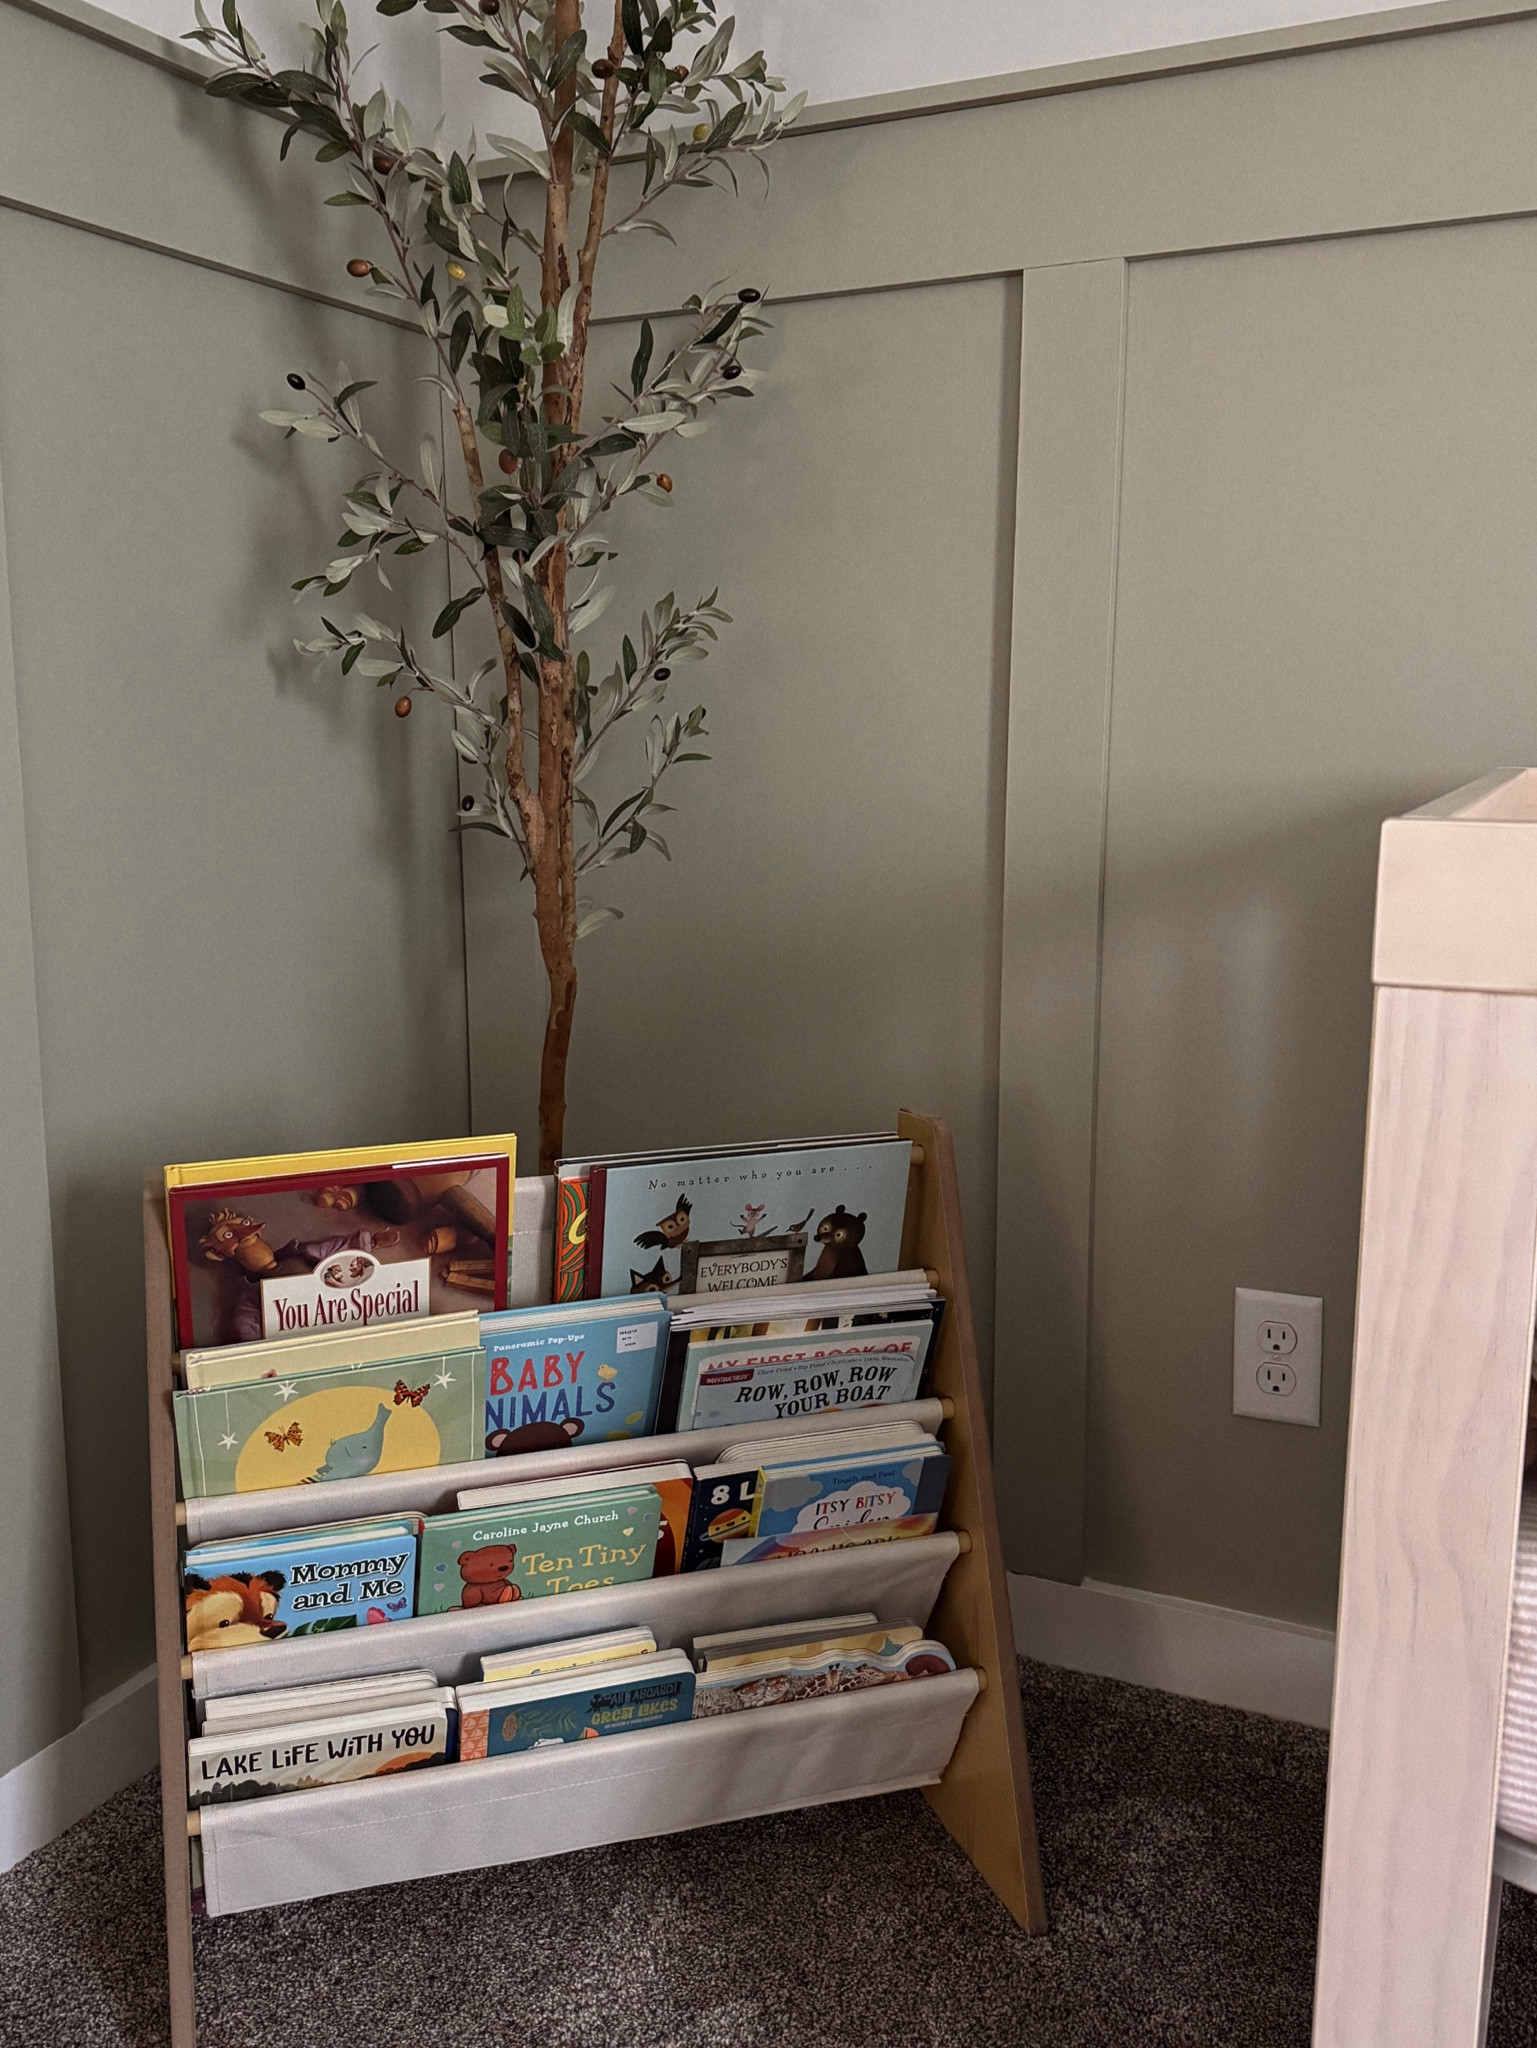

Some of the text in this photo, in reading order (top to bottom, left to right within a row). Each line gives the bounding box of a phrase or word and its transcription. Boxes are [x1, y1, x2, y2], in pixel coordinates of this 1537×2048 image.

[648, 1179, 666, 1190] No
[677, 1175, 730, 1187] matter
[739, 1170, 767, 1181] who
[776, 1168, 802, 1180] you
[700, 1258, 788, 1278] EVERYBODY'S
[708, 1275, 778, 1292] WELCOME
[272, 1280, 419, 1332] You Are Special
[493, 1334, 585, 1352] Panoramic Pop-Ups
[490, 1351, 585, 1396] BABY
[734, 1366, 898, 1403] ROW, ROW, ROW
[486, 1381, 616, 1431] NIMALS
[774, 1385, 892, 1418] YOUR BOAT
[711, 1484, 730, 1505] 8
[815, 1492, 897, 1515] ITSY BITSY
[472, 1511, 619, 1541] Caroline Jayne Church
[290, 1553, 409, 1585] Mommy
[521, 1544, 647, 1576] Ten Tiny
[293, 1580, 404, 1610] and Me
[201, 1752, 262, 1780] LAKE
[392, 1724, 436, 1748] YOU
